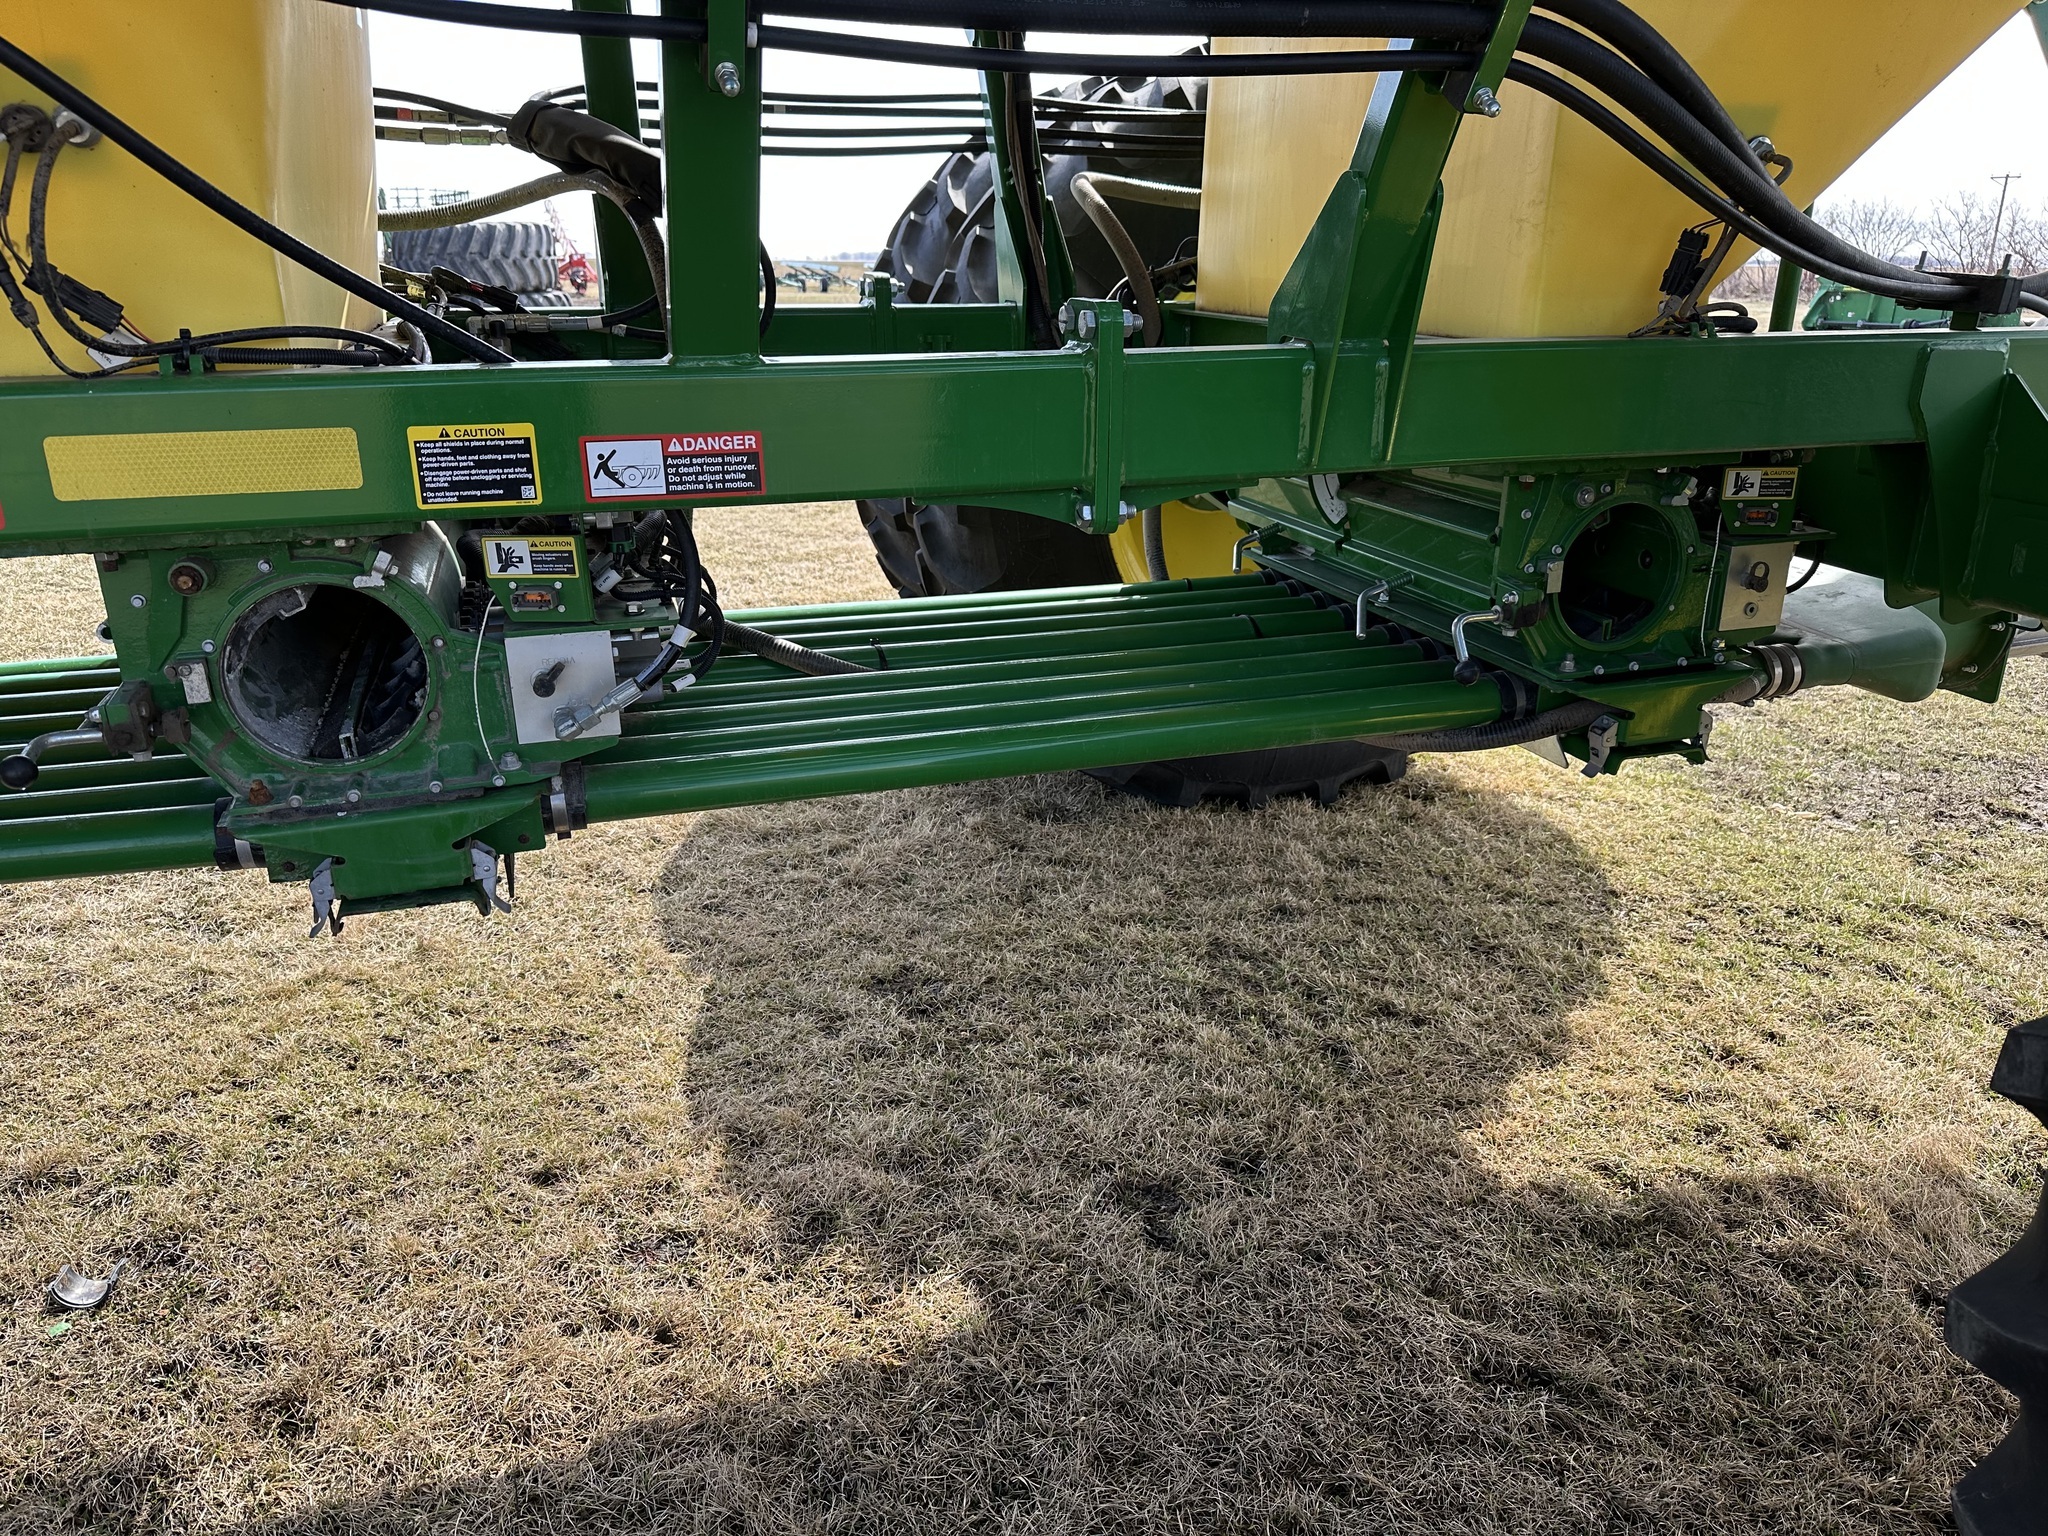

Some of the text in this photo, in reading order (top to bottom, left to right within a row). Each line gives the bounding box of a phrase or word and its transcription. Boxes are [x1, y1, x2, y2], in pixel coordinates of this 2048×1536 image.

[453, 427, 505, 438] CAUTION
[486, 439, 504, 447] during
[683, 435, 756, 451] DANGER
[479, 453, 501, 461] clothing
[667, 455, 748, 465] Avoid serious injury
[678, 465, 701, 473] death
[703, 464, 723, 472] from
[724, 463, 757, 471] runover.
[682, 474, 696, 482] not
[697, 473, 723, 482] adjust
[724, 472, 746, 480] while
[669, 482, 704, 491] machine
[715, 481, 723, 489] in
[725, 480, 755, 488] motion.
[538, 540, 572, 548] CAUTION
